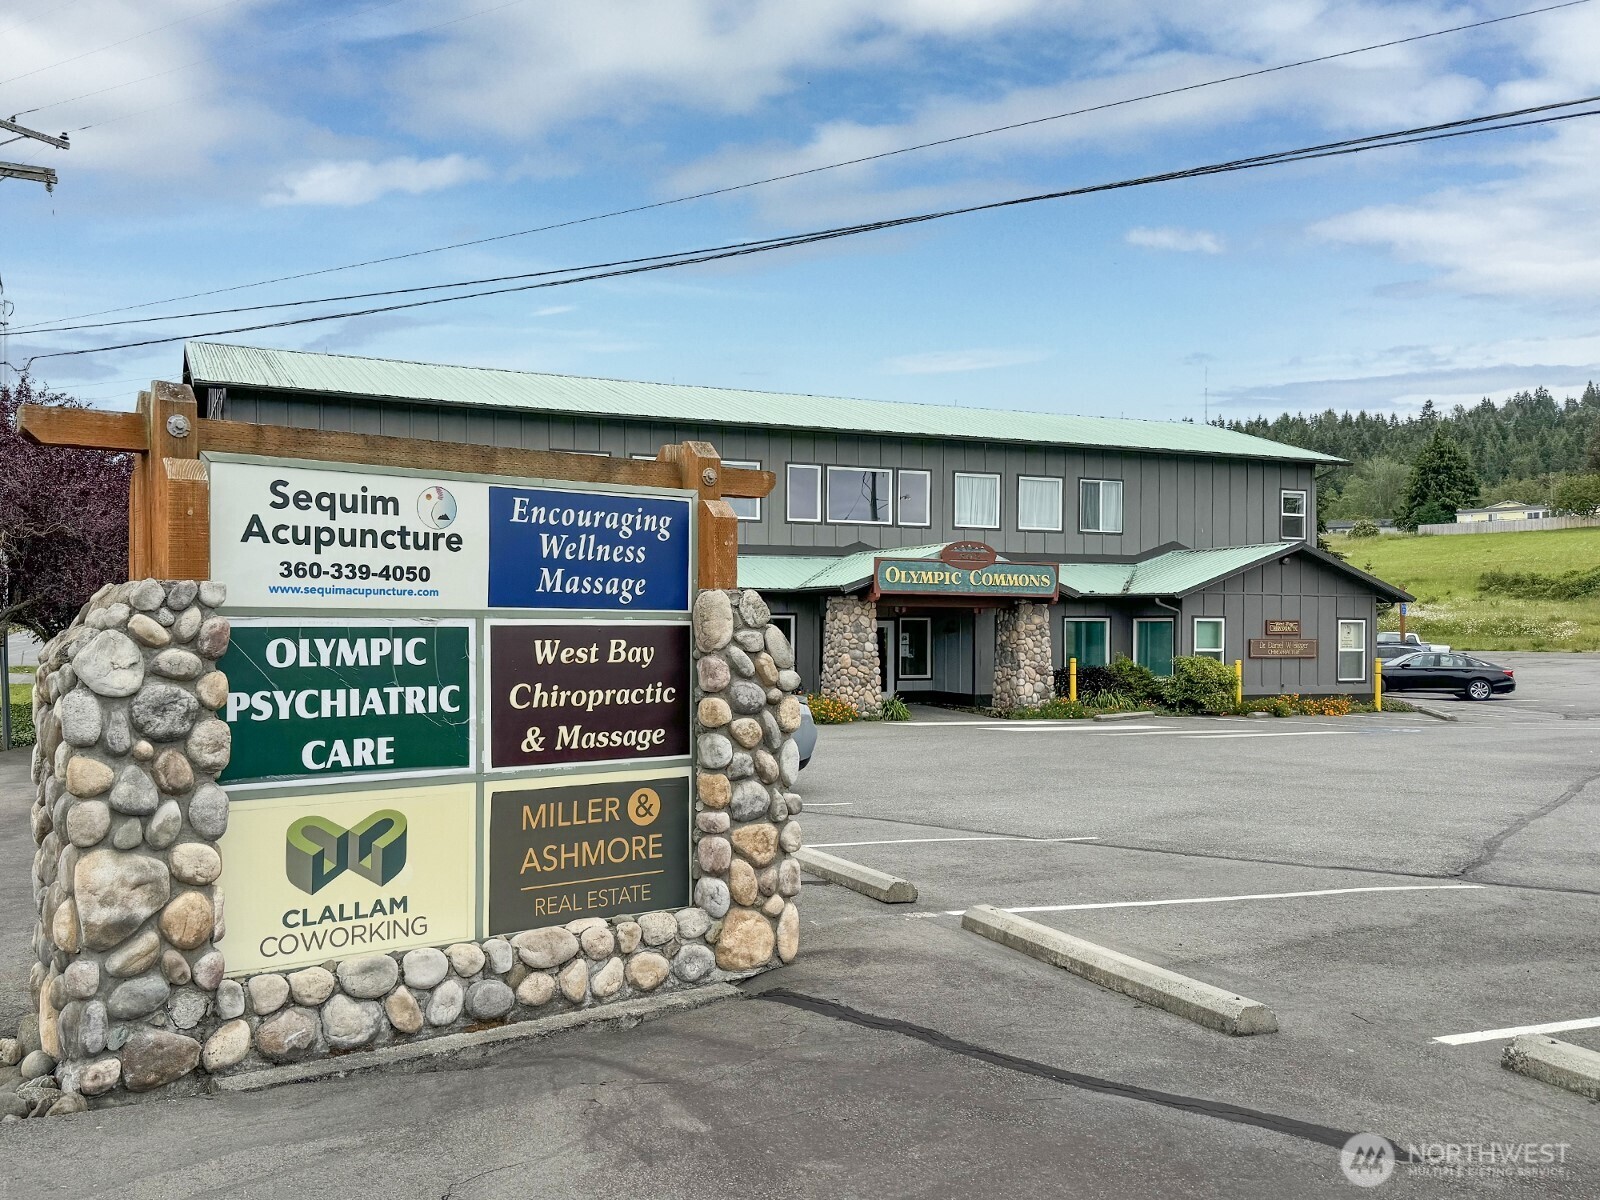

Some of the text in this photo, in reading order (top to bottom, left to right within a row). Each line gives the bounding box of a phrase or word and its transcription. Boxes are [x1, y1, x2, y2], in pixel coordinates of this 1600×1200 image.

[269, 479, 400, 520] Sequim
[240, 514, 463, 554] Acupuncture
[510, 497, 673, 542] Encouraging
[539, 533, 646, 564] Wellness
[279, 561, 431, 582] 360-339-4050
[535, 567, 646, 604] Massage
[885, 566, 1051, 587] OLYMPIC COMMONS
[268, 583, 439, 598] www.sequimacupuncture.com
[265, 637, 427, 668] OLYMPIC
[533, 639, 655, 668] West Bay
[226, 685, 460, 722] PSYCHIATRIC
[509, 681, 676, 712] Chiropractic
[301, 736, 395, 770] CARE
[520, 723, 666, 755] & Massage
[521, 792, 655, 832] MILLER &
[519, 833, 663, 875] ASHMORE
[281, 895, 408, 929] CLALLAM
[535, 883, 652, 917] REAL ESTATE
[259, 916, 428, 958] COWORKING
